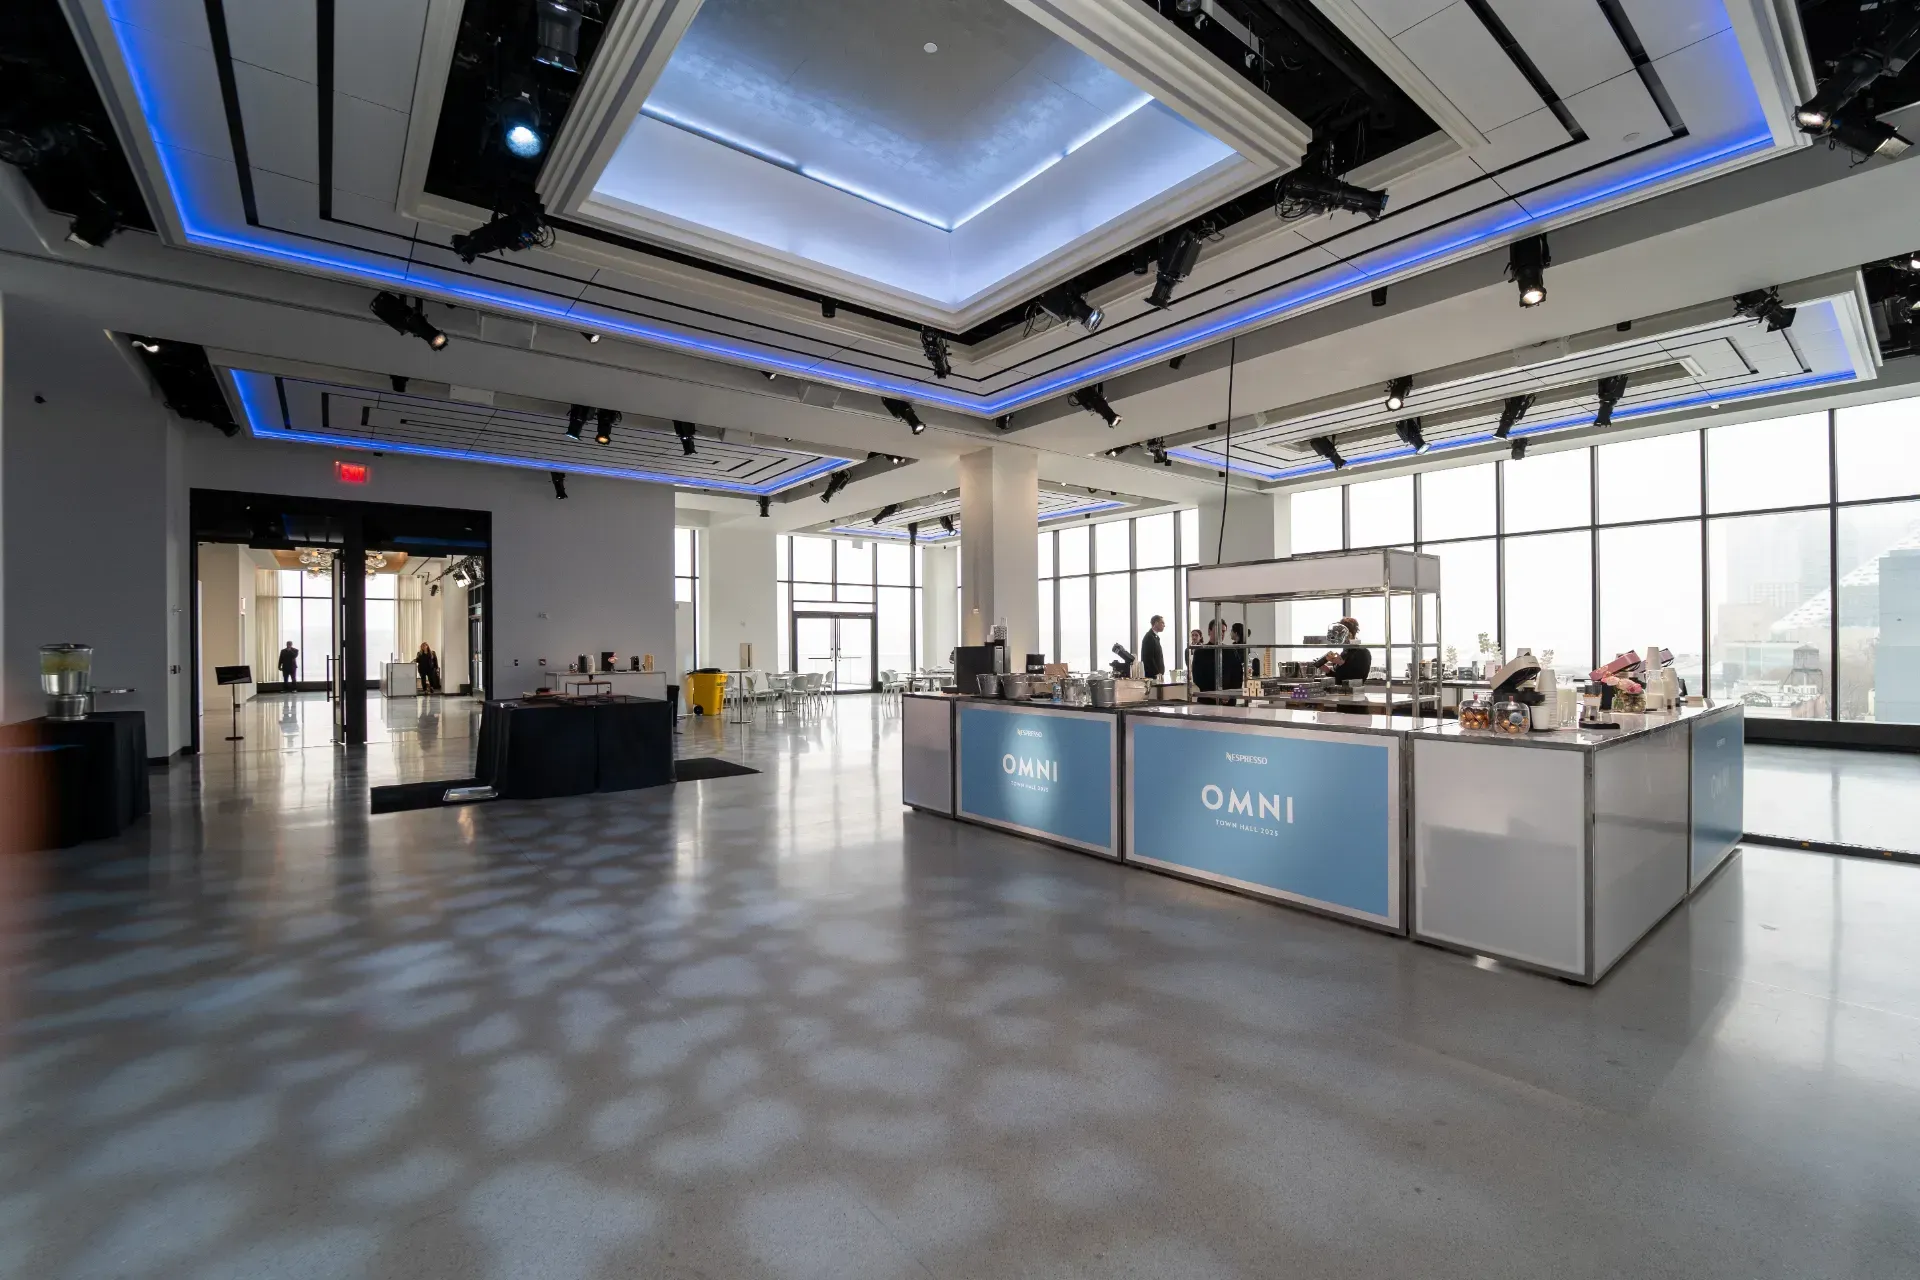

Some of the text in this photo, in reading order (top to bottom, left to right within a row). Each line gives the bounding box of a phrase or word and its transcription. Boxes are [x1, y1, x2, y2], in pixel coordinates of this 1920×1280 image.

[1002, 753, 1058, 783] OMNI
[1226, 752, 1268, 765] NESPRESSO
[1201, 784, 1294, 824] OMNI
[1215, 819, 1279, 837] TOWN HALL 2025
